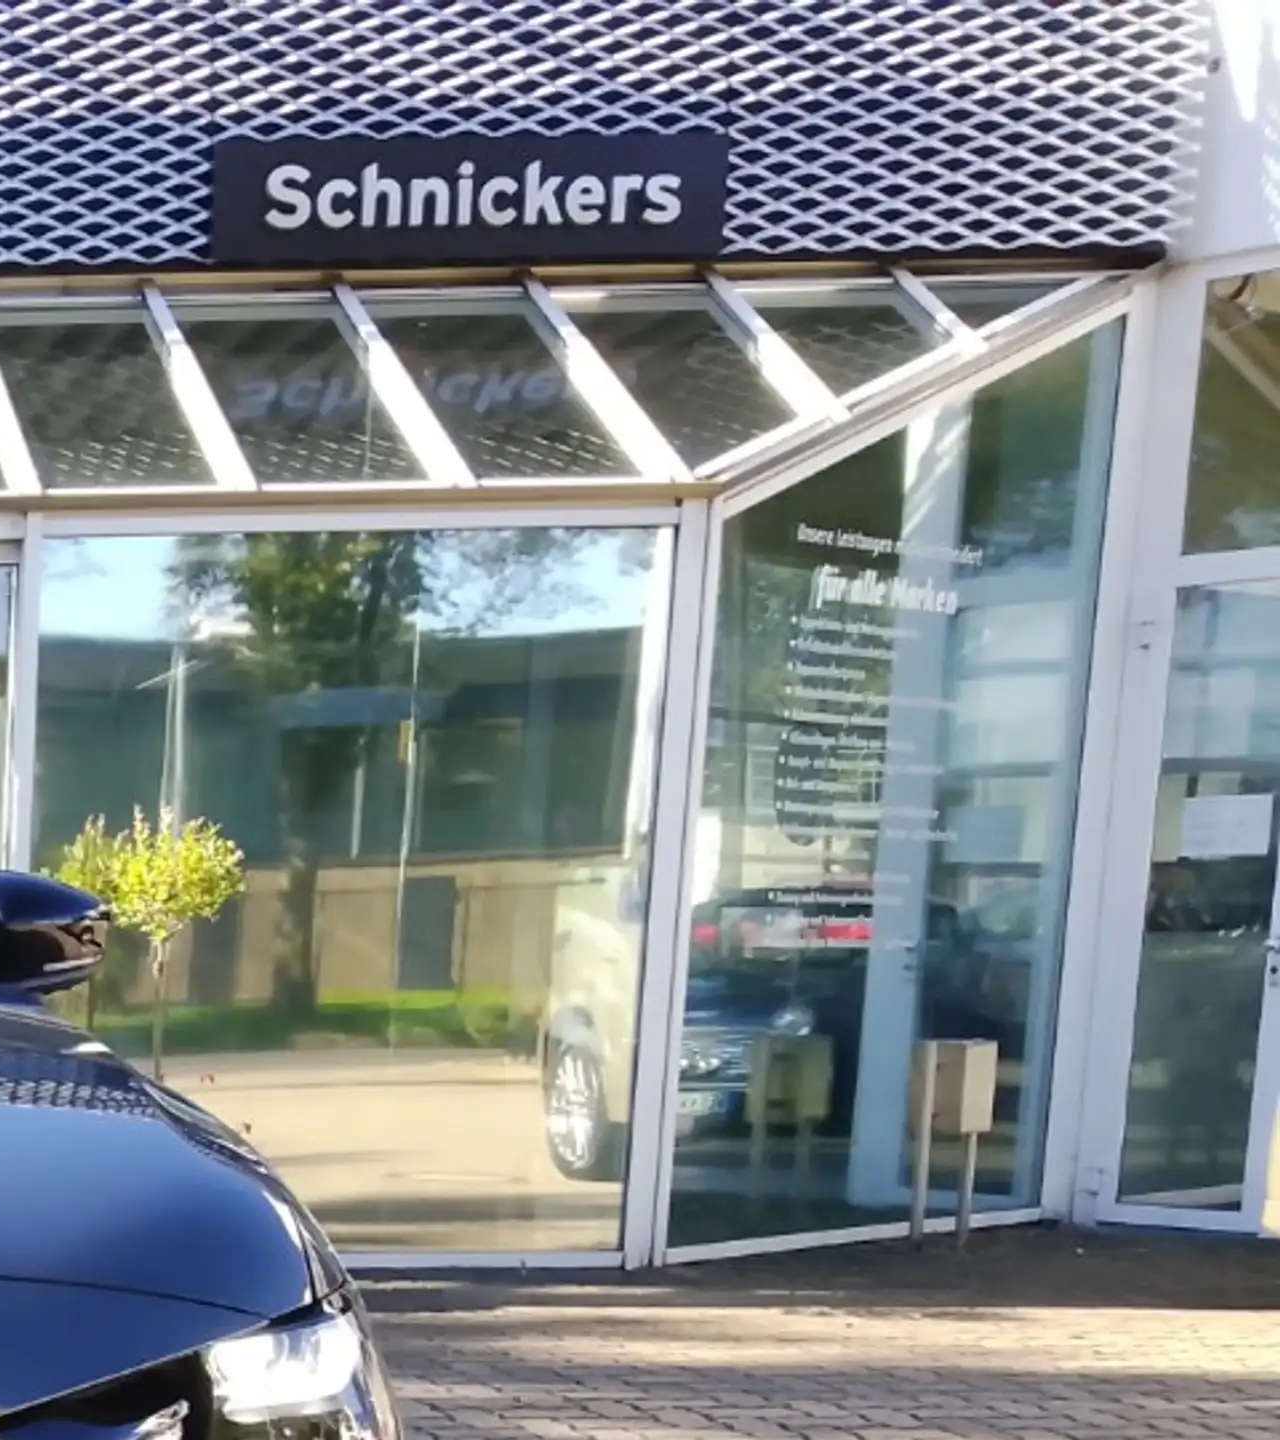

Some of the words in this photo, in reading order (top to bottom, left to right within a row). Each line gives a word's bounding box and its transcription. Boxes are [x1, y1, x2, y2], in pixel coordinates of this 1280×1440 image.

[264, 159, 682, 230] Schnickers
[814, 562, 848, 611] für
[849, 568, 887, 607] alle
[889, 575, 958, 615] Marken
